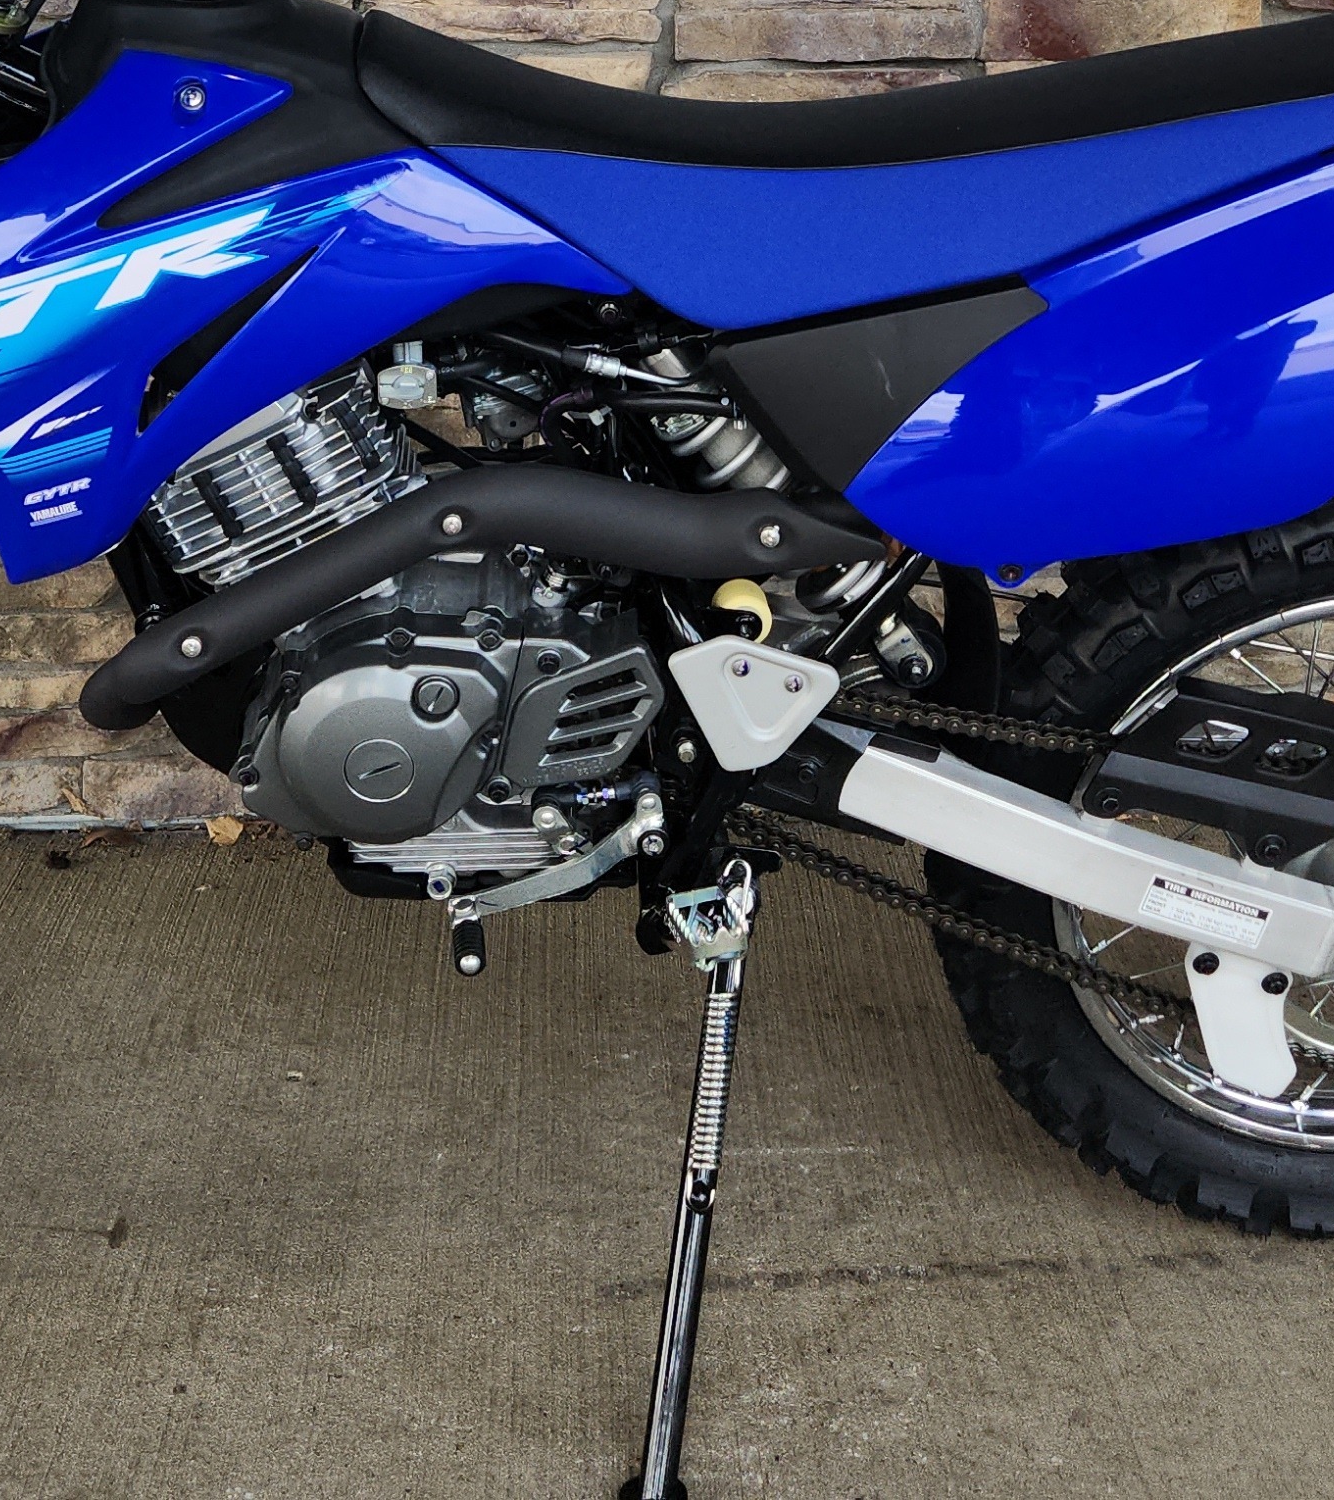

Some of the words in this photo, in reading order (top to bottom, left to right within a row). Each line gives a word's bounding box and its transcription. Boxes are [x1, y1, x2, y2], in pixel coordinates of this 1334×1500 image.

[24, 477, 92, 506] GYTR
[30, 501, 78, 522] YAMALUBE
[1163, 879, 1189, 897] TIRE
[1190, 888, 1261, 919] INFORMATION
